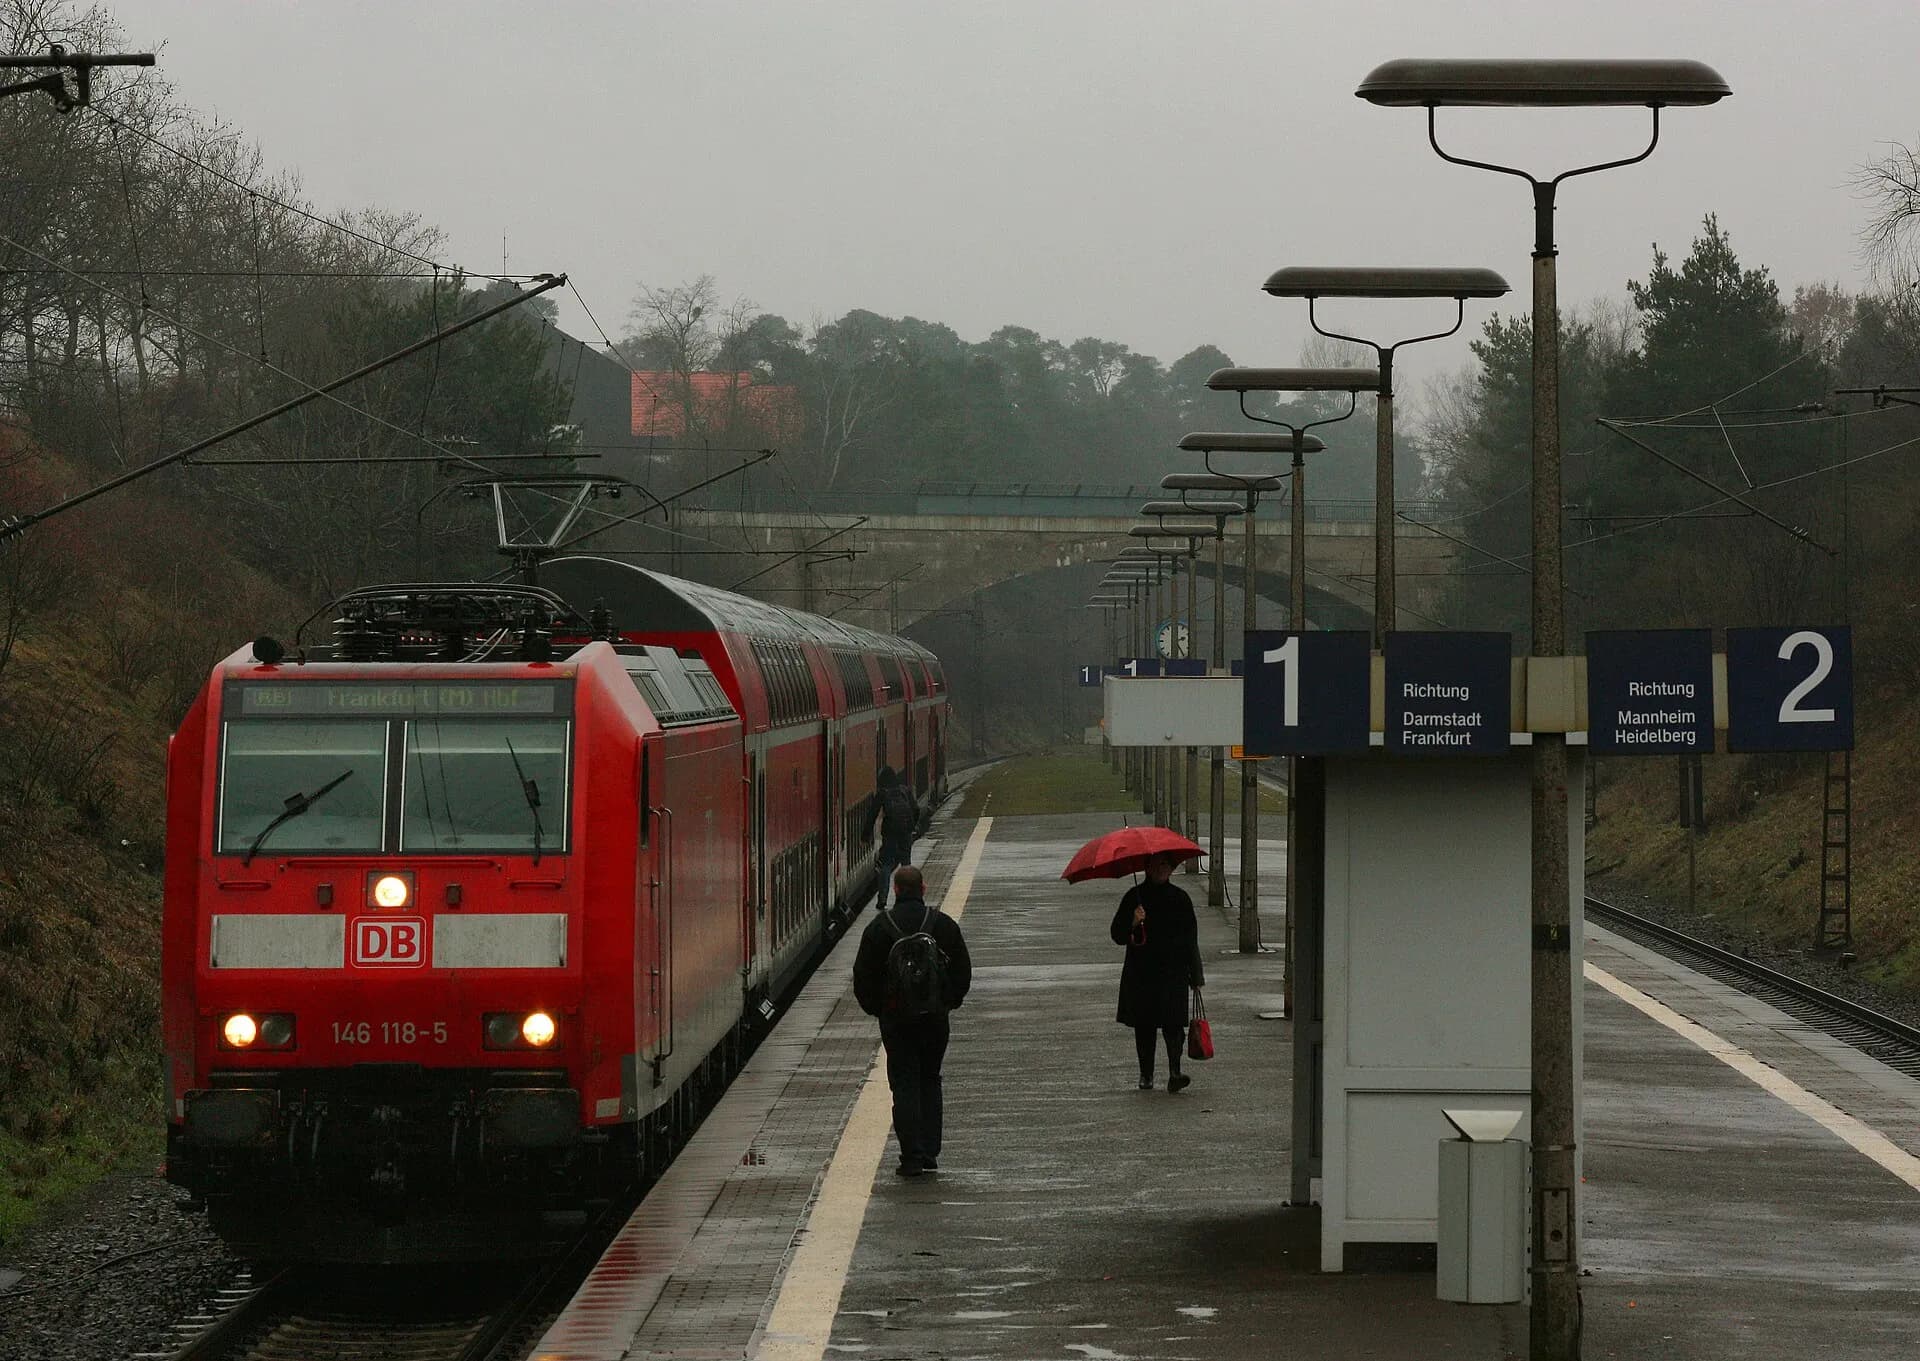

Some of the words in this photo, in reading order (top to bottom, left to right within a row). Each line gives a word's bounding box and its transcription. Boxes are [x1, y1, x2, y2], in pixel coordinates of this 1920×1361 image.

[1081, 666, 1090, 683] 1
[1262, 636, 1299, 727] 1
[1777, 631, 1835, 723] 2
[1403, 683, 1470, 701] Richtung
[1628, 682, 1696, 698] Richtung
[1403, 711, 1482, 726] Darmstadt
[1617, 710, 1696, 725] Mannheim
[1402, 730, 1472, 745] Frankfurt
[1614, 729, 1697, 745] Heidelberg
[360, 925, 417, 960] DB
[332, 1022, 371, 1044] 146
[381, 1022, 448, 1044] 118-5
